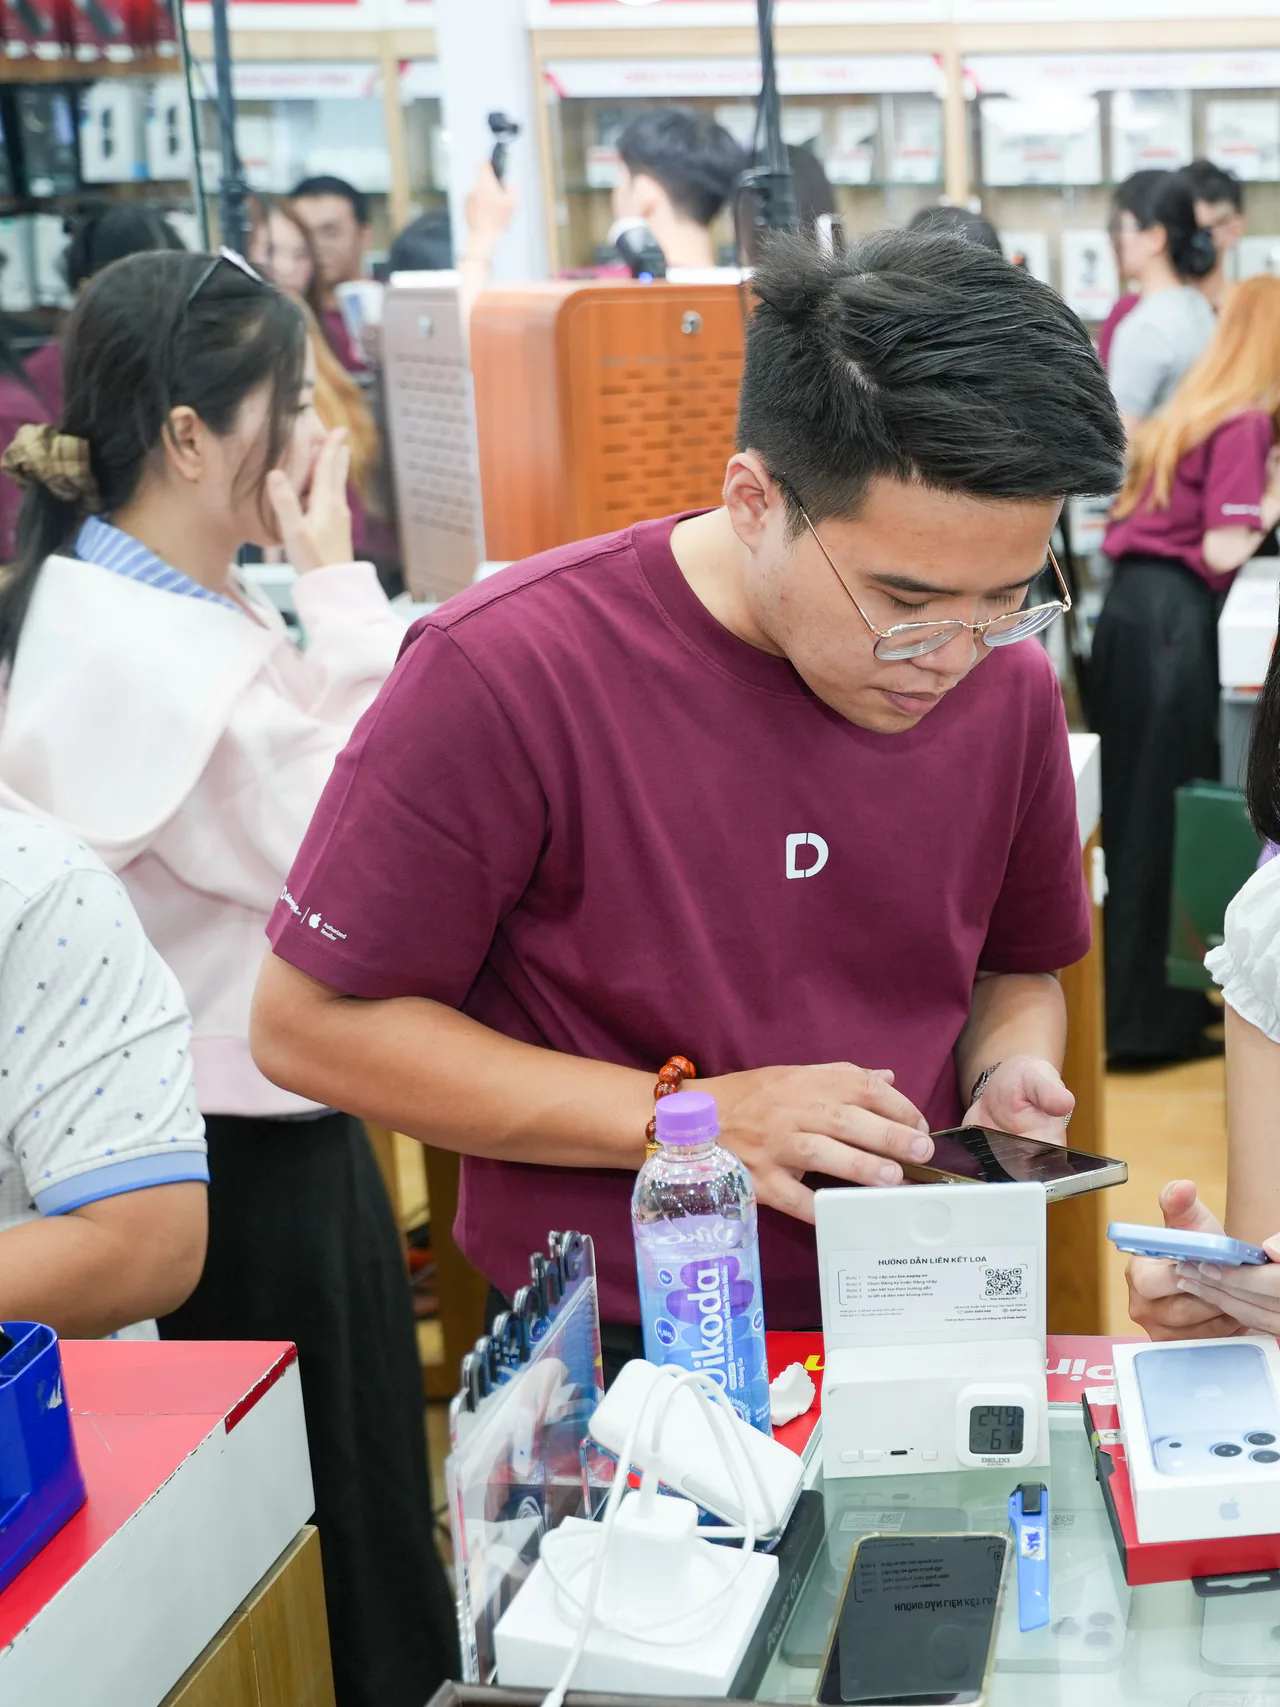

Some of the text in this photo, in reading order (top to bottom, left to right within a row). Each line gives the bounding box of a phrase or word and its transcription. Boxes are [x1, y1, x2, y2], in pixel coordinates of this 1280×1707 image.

[786, 832, 829, 879] D
[878, 1257, 908, 1266] HƯỚNG
[910, 1256, 928, 1265] DẪN
[929, 1256, 950, 1264] LIÊN
[951, 1255, 968, 1263] KẾT
